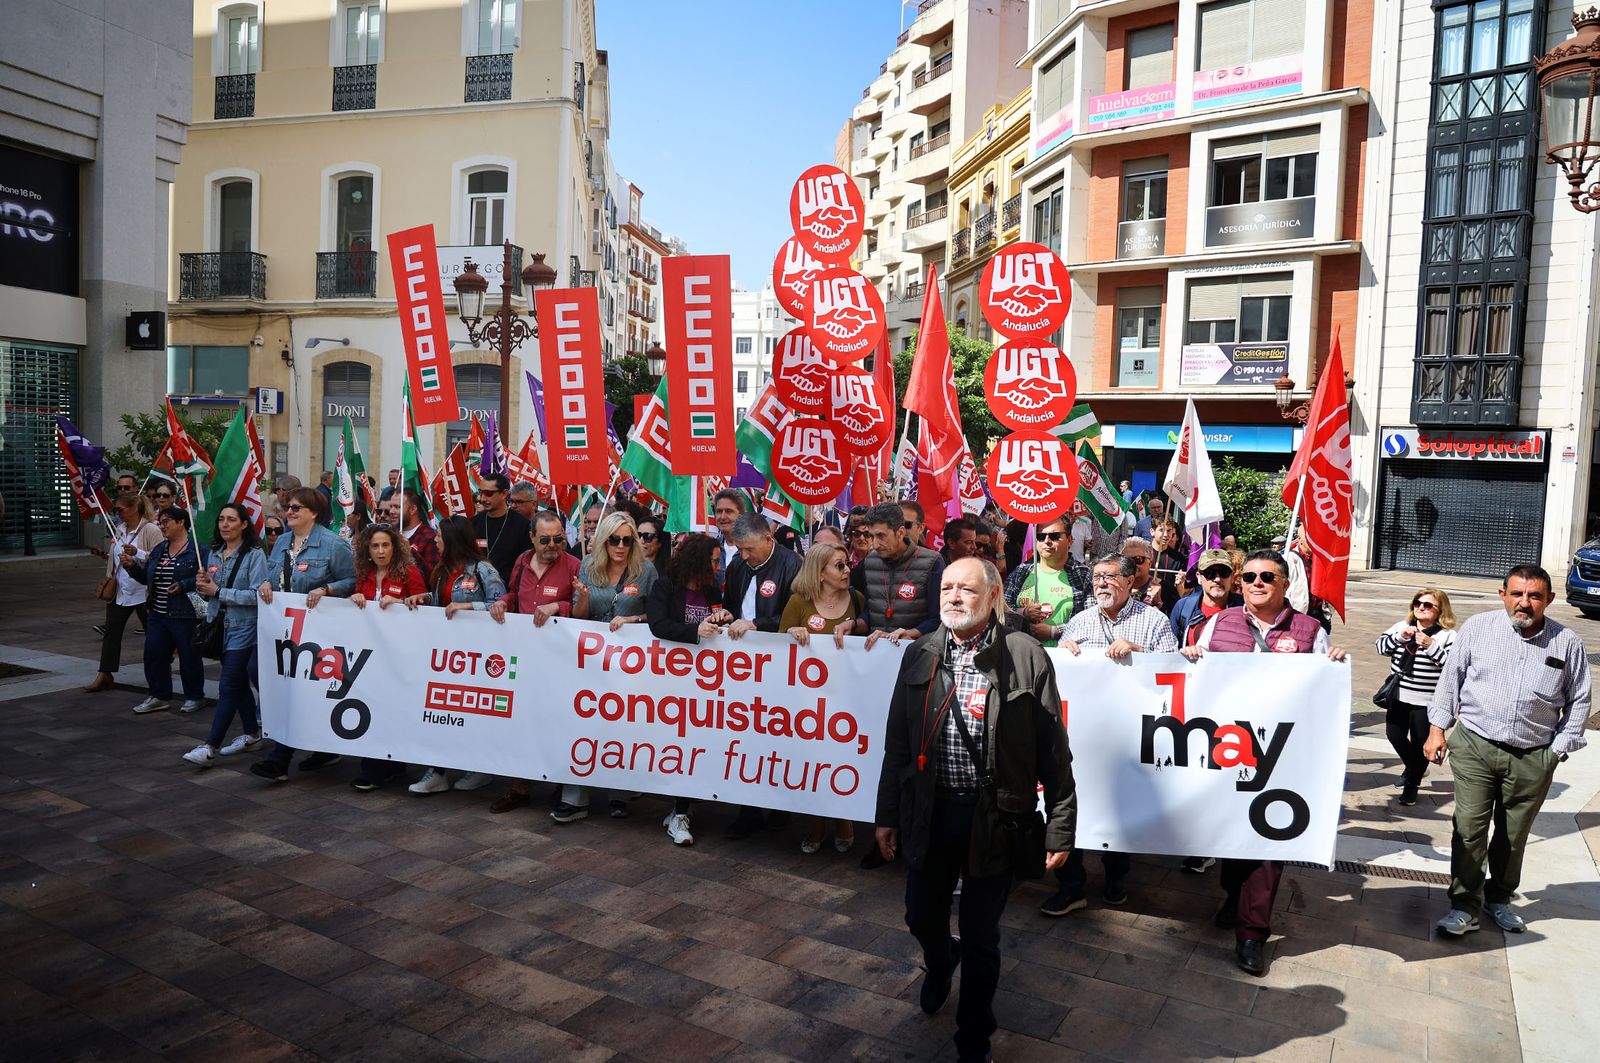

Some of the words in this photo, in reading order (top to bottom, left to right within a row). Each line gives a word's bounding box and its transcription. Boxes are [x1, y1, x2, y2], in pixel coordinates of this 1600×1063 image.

[1210, 86, 1240, 97] Francisco
[1097, 89, 1173, 112] huelvaderm
[20, 188, 28, 197] 16
[29, 191, 42, 201] Pro
[799, 173, 849, 215] UGT
[1262, 219, 1301, 232] JURÍDICA
[813, 238, 851, 254] Andalucía
[992, 252, 1055, 290] UGT
[814, 276, 870, 314] UGT
[1001, 317, 1051, 332] Andalucía
[826, 336, 869, 353] Andalucía
[997, 347, 1061, 383] UGT
[1243, 366, 1255, 374] 959
[1256, 366, 1265, 374] 04
[424, 395, 442, 404] HUELVA
[790, 391, 824, 406] Andaluc
[831, 375, 875, 409] UGT
[328, 403, 366, 418] DIONI
[1006, 409, 1056, 424] Andalucía
[781, 425, 837, 462] UGT
[844, 432, 879, 447] Andalucía
[1417, 432, 1541, 458] Soloptical
[691, 444, 717, 453] HUELVA
[566, 453, 590, 462] HUELVA
[999, 439, 1063, 475] UGT
[789, 480, 831, 496] Andalucía
[1009, 499, 1057, 514] Andalucía
[430, 648, 482, 676] UGT
[577, 631, 772, 691] Proteger
[788, 643, 829, 689] lo
[423, 710, 465, 727] Huelva
[573, 689, 869, 755] conquistado,
[569, 737, 706, 777] ganar
[724, 740, 860, 796] futuro
